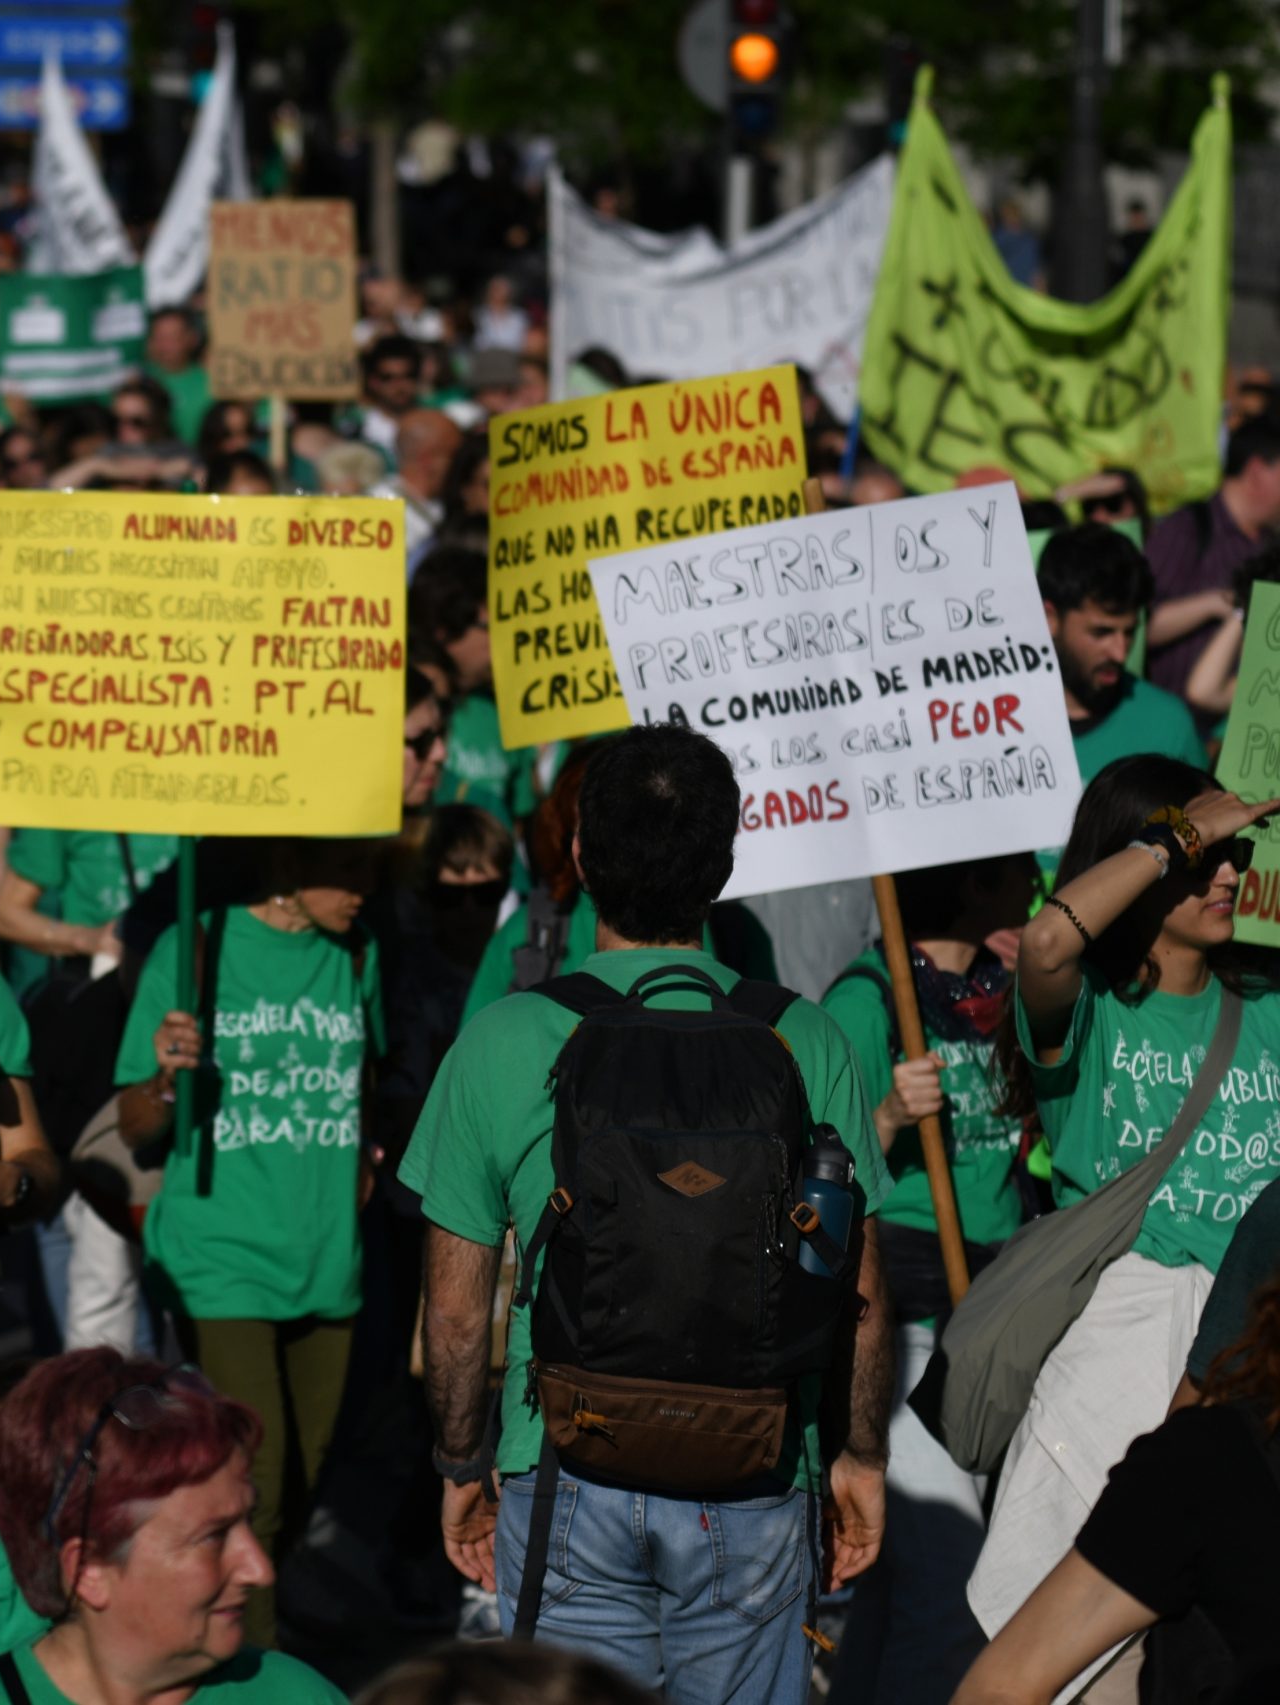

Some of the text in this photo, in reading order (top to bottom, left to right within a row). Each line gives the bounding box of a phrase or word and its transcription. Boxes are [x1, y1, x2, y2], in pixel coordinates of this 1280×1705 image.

[218, 260, 345, 310] RATIO
[497, 380, 782, 467] SOMOS LA ÚNICA
[494, 435, 797, 518] COMUNIDAD DE ESPAÑA
[123, 514, 237, 543] ALUMNADO
[248, 517, 276, 546] ES
[288, 511, 393, 549] DIVERSO
[495, 492, 801, 569] QUE NO HA RECUPERADO
[968, 501, 996, 567] Y
[232, 557, 336, 589] APOYO.
[496, 570, 593, 622] LAS HO
[35, 585, 153, 620] NUESTROS
[159, 591, 264, 623] CENTROS
[282, 597, 391, 629] FALTAN
[946, 589, 1003, 632] DE
[217, 635, 235, 665] Y
[252, 635, 402, 671] PROFESORADO
[513, 613, 609, 665] PREVI
[643, 636, 1054, 727] LA COMUNIDAD DE MADRID:
[23, 718, 278, 758] COMPENSATORIA
[772, 732, 827, 769] LOS
[841, 708, 912, 756] CASI
[927, 693, 1023, 743] PEOR
[2, 758, 98, 798] PARA
[736, 745, 1056, 836] GADOS DE ESPAÑA
[230, 1069, 269, 1096] DE
